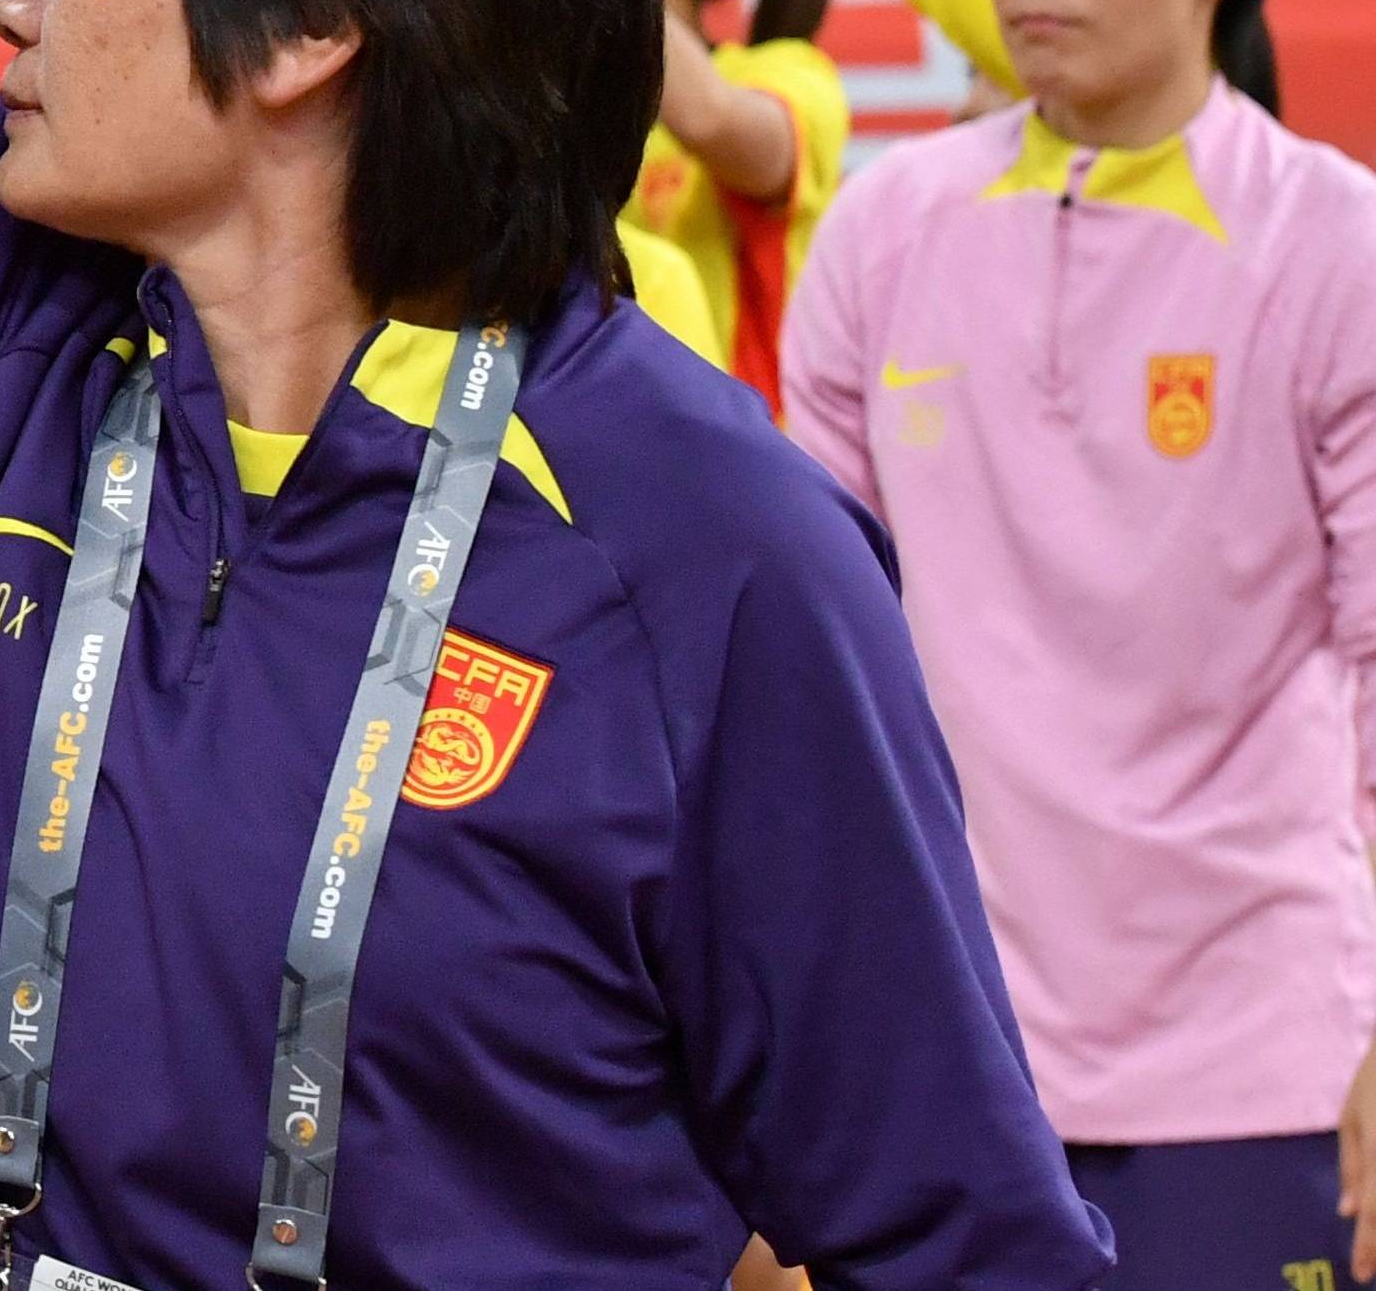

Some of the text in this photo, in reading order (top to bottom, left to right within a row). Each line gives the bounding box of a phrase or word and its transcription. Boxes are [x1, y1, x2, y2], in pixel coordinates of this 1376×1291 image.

[102, 451, 137, 522] AFC
[408, 520, 451, 597] AFC
[435, 645, 532, 707] CFA
[453, 686, 492, 715] 中国
[38, 633, 104, 853] the-AFC.com
[311, 719, 391, 939] the-AFC.com
[8, 980, 43, 1062] AFC
[285, 1064, 321, 1147] AFC
[68, 1269, 135, 1291] AFC WO
